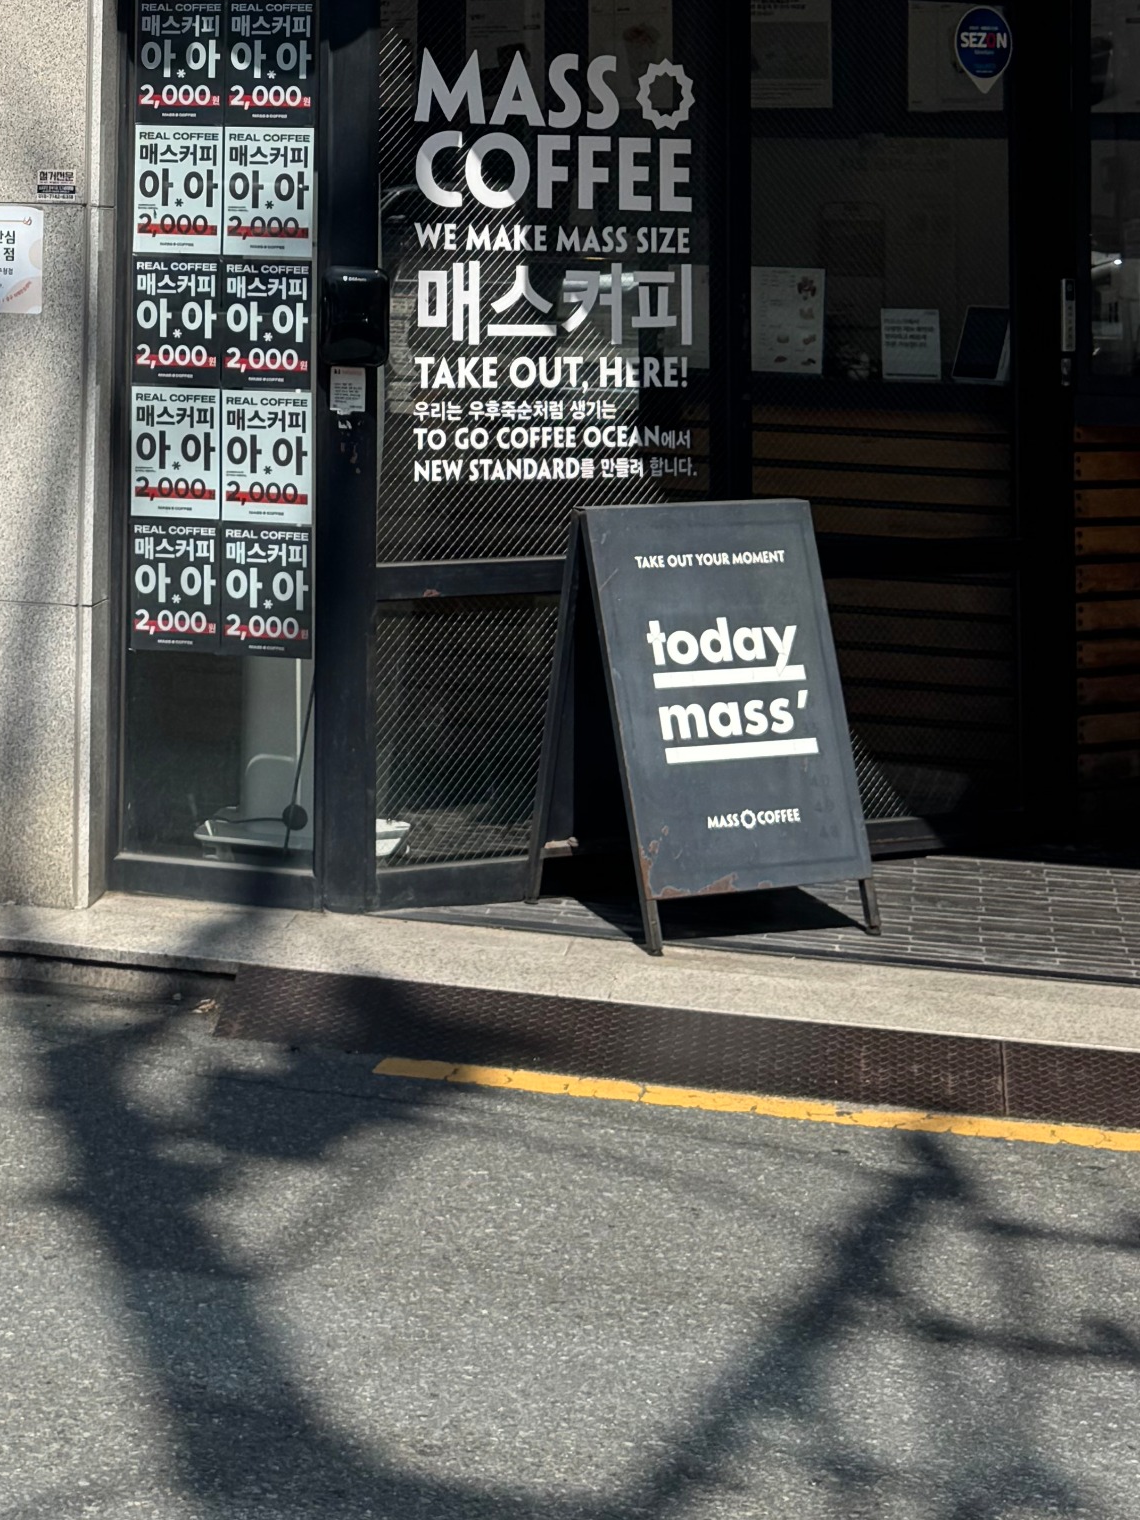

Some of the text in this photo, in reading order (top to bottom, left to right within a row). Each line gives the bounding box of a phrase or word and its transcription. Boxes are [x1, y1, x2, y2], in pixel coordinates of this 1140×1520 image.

[141, 3, 221, 12] REAL COFFEE
[231, 3, 313, 12] REAL COFFEE
[141, 15, 220, 37] 매스커피
[231, 15, 310, 37] 매스커피
[414, 47, 620, 129] MASS
[139, 132, 219, 141] REAL COFFEE
[229, 133, 310, 143] REAL COFFEE
[139, 143, 217, 166] 매스커피
[229, 145, 308, 168] 매스커피
[415, 131, 692, 212] COFFEE
[414, 222, 691, 254] WE MAKE MASS SIZE
[136, 262, 217, 272] REAL COFFEE
[227, 264, 309, 274] REAL COFFEE
[137, 273, 215, 297] 매스커피
[227, 276, 307, 300] 매스커피
[417, 260, 692, 345] 매스커피
[414, 357, 688, 393] TAKE OUT, HERE!
[136, 393, 216, 403] REAL COFFEE
[226, 397, 308, 407] REAL COFFEE
[136, 405, 214, 429] 매스커피
[226, 409, 306, 433] 매스커피
[413, 401, 617, 420] 우리는 우후죽순처럼 생기는
[413, 428, 446, 450] TO
[455, 428, 489, 450] GO
[496, 427, 576, 449] COFFEE
[413, 458, 462, 482] NEW
[601, 457, 644, 478] 만들려
[650, 456, 697, 477] 합니다.
[134, 524, 216, 536] REAL COFFEE
[225, 529, 309, 541] REAL COFFEE
[134, 537, 215, 562] 매스커피
[226, 541, 307, 568] 매스커피
[635, 550, 785, 569] TAKE OUT YOUR MOMENT
[647, 616, 798, 677] today
[707, 808, 801, 829] MASS COFFEE
